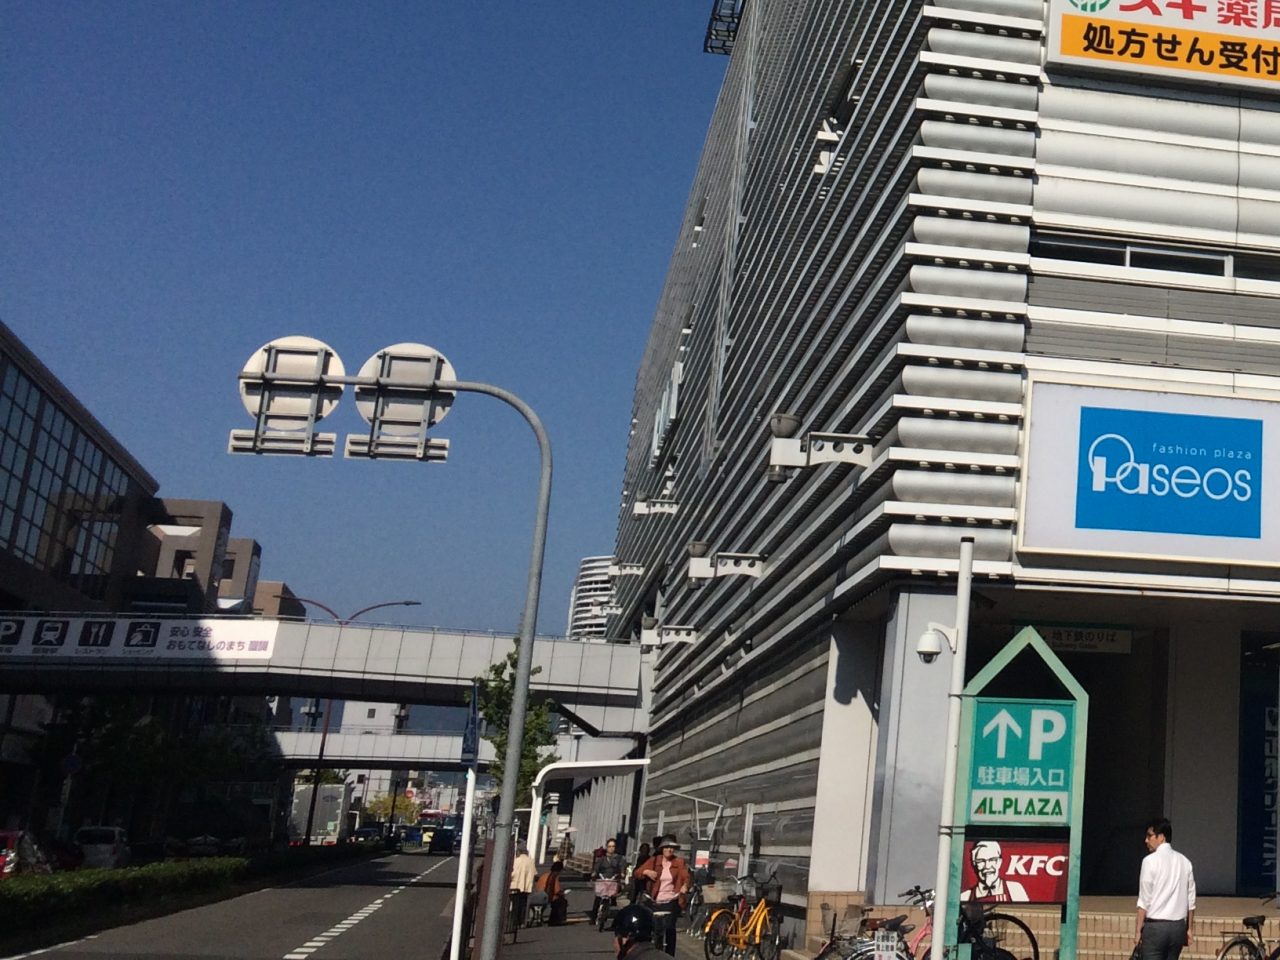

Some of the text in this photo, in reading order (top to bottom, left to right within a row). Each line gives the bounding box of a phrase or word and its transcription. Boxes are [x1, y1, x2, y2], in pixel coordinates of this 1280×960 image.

[1152, 442, 1252, 460] fashion plaza
[1088, 433, 1251, 502] Paseos
[1028, 709, 1067, 760] P
[977, 766, 1065, 786] 駐車場入口
[974, 797, 1063, 815] AL.PLAZA
[1005, 855, 1066, 876] KFC
